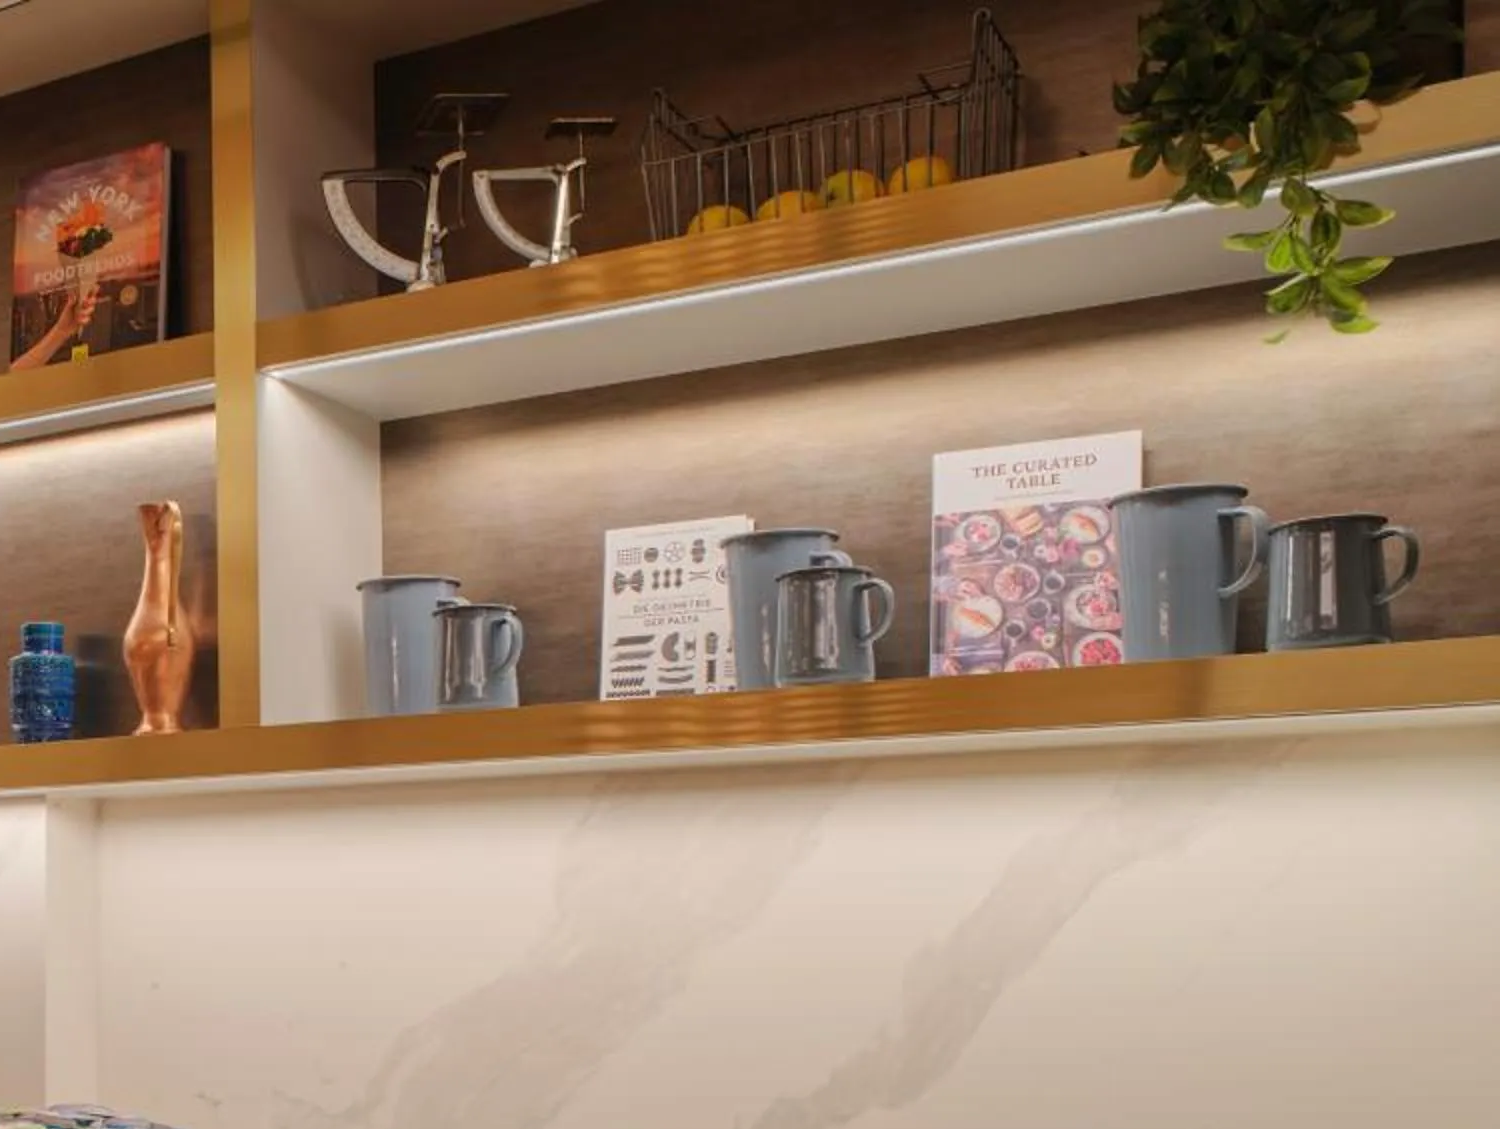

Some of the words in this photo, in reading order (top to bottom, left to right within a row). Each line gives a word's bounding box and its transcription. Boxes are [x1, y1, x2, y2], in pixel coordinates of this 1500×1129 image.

[36, 191, 78, 242] NEW
[88, 185, 143, 222] YORK
[972, 463, 1006, 479] THE
[1012, 452, 1098, 474] CURATED
[1006, 473, 1061, 490] TABLE
[667, 615, 700, 626] PASTA
